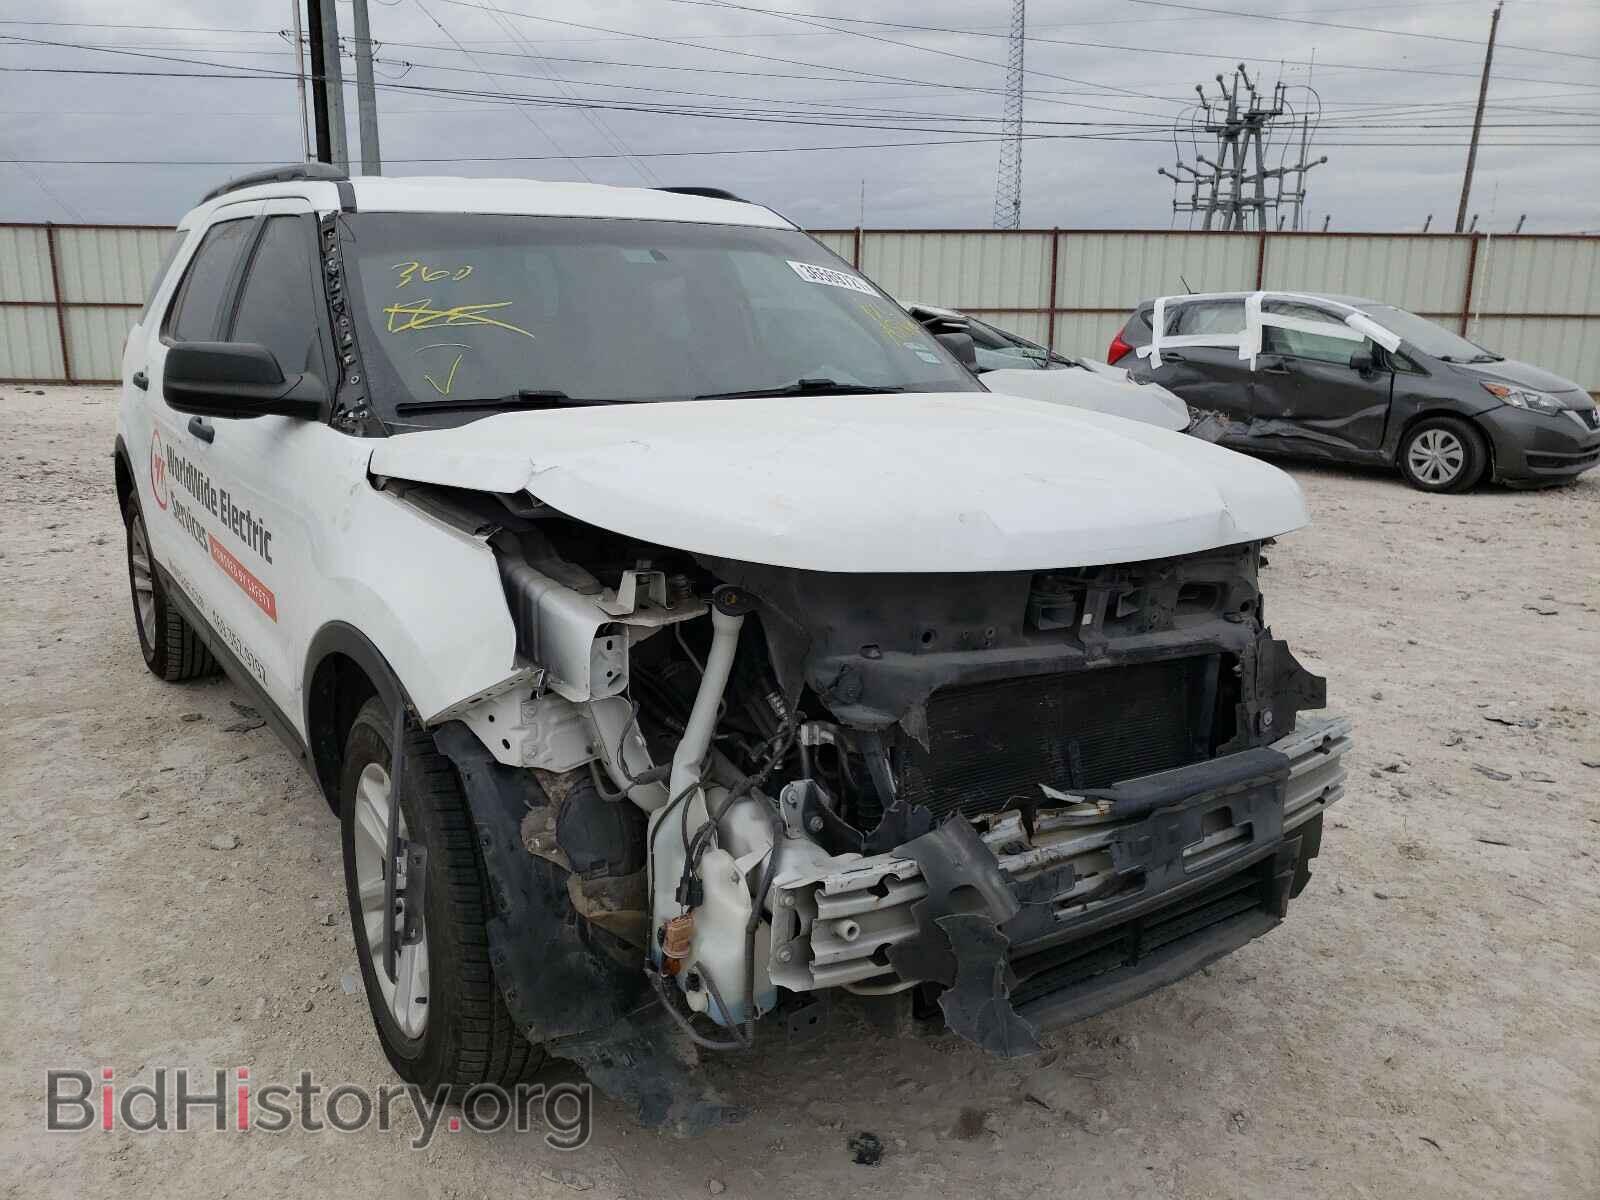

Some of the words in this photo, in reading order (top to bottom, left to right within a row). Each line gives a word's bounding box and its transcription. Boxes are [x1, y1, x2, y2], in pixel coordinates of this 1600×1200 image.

[391, 261, 473, 289] 360
[166, 443, 218, 517] WorldWide
[219, 487, 273, 566] Electric
[170, 489, 209, 553] Services
